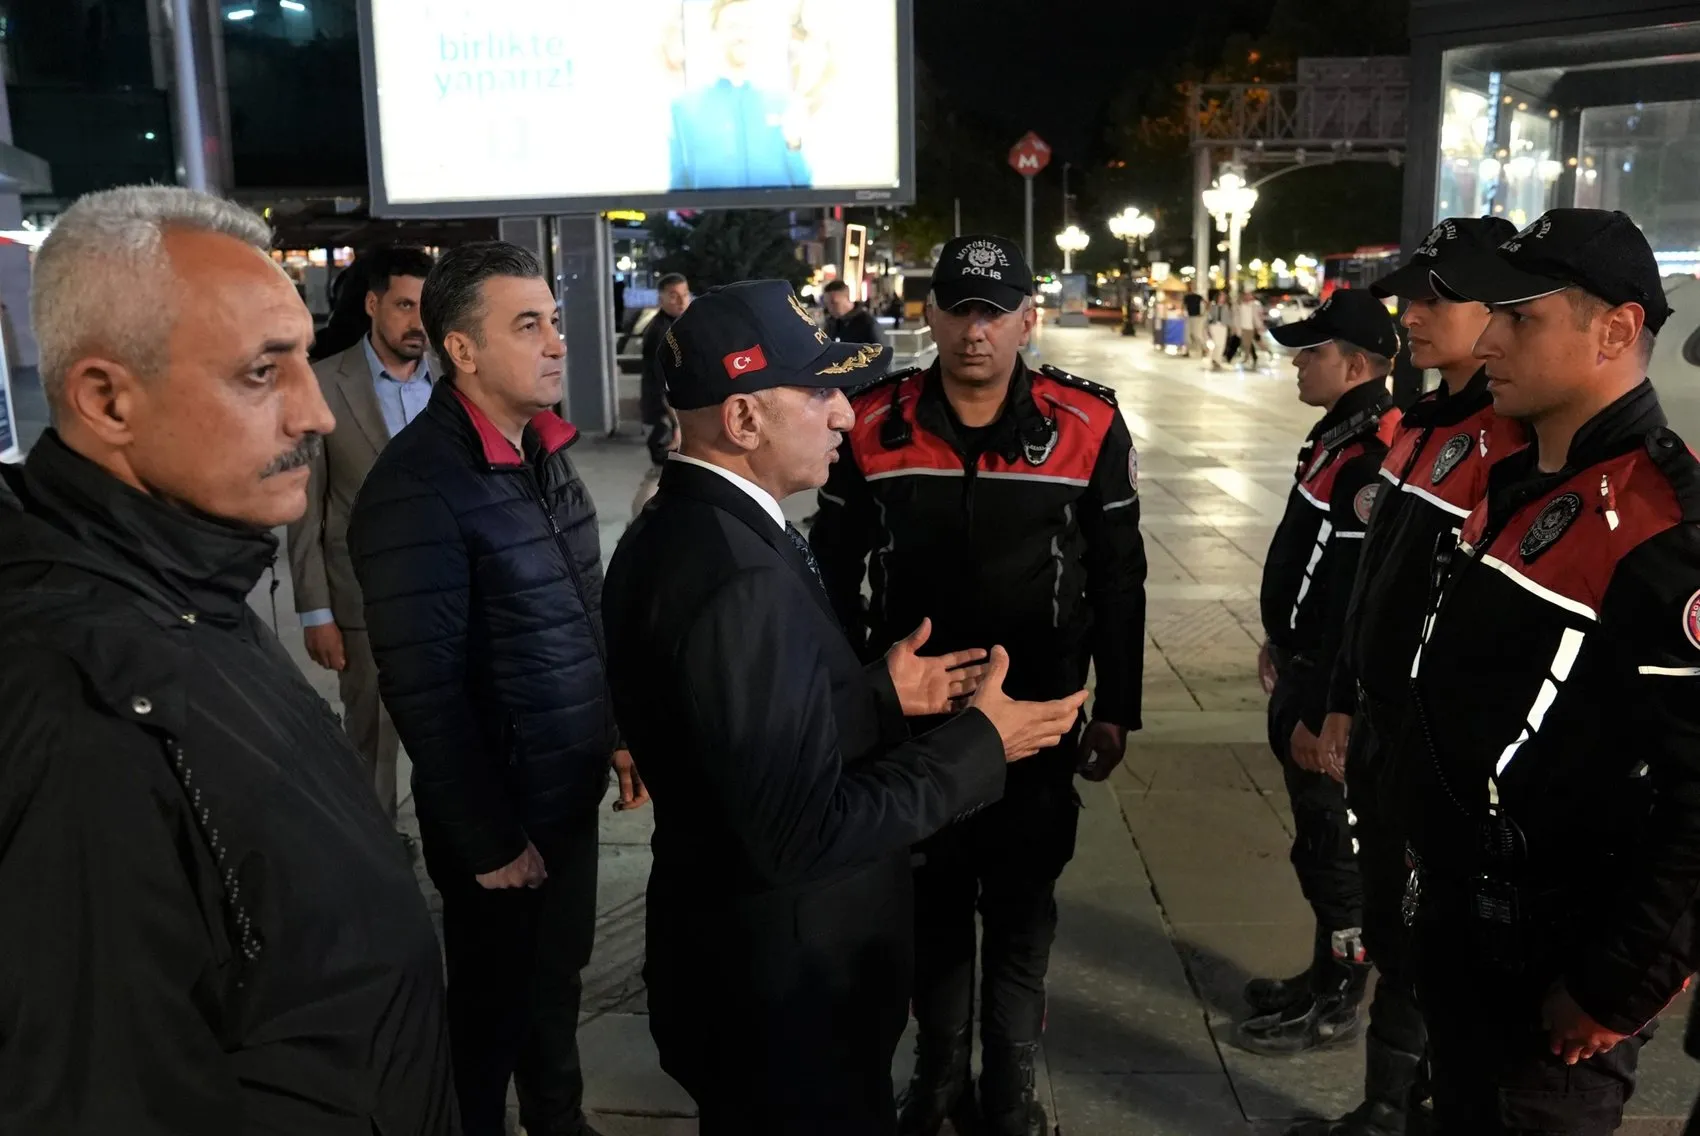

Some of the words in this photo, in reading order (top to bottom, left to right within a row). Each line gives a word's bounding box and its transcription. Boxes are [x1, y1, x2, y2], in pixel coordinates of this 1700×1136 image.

[437, 29, 564, 61] birlikte
[433, 57, 575, 100] yaparız!
[1017, 153, 1039, 168] M
